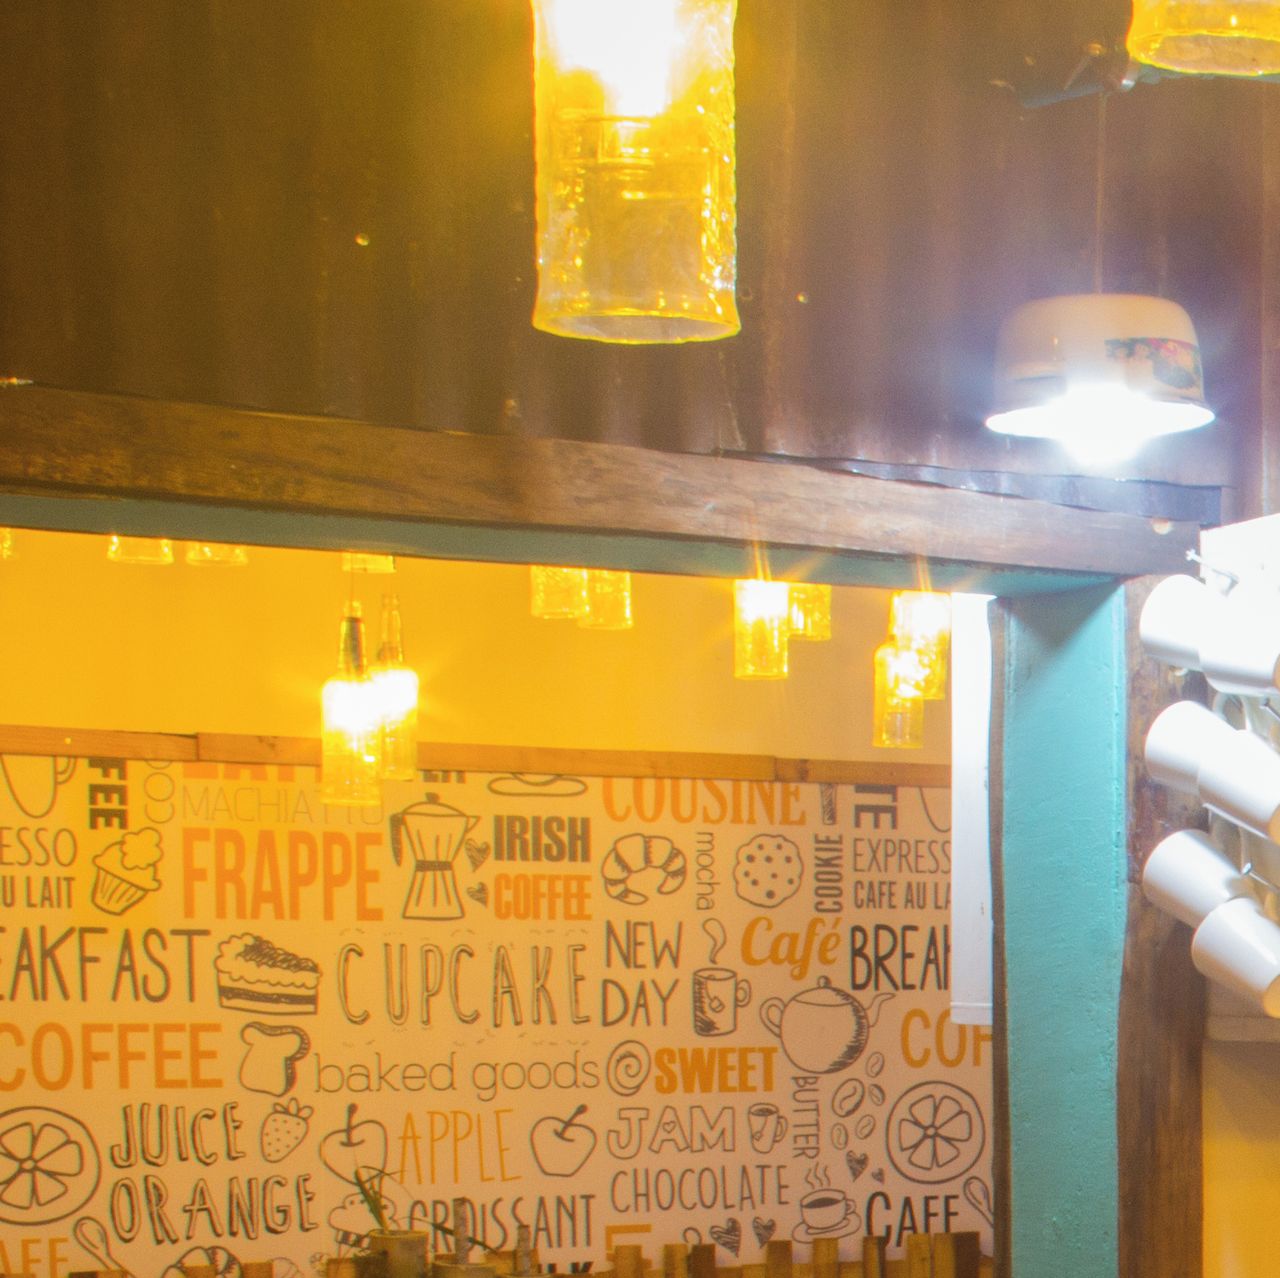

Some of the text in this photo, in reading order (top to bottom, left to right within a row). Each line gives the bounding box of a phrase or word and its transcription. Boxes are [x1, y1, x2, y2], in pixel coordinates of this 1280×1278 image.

[493, 815, 591, 863] IRISH
[696, 831, 721, 911] mocha
[25, 875, 76, 909] LAIT
[182, 826, 385, 921] FRAPPE
[493, 873, 593, 922] COFFEE
[814, 833, 843, 913] COOKIE
[853, 880, 897, 909] CAFE
[904, 882, 926, 909] AU
[0, 925, 212, 1003] AKFAST
[605, 920, 684, 970] NEW
[740, 916, 843, 981] Café
[337, 942, 592, 1029] CUPCAKE
[602, 978, 680, 1027] DAY
[0, 1022, 223, 1091] COFFEE
[314, 1050, 600, 1101] baked goods
[653, 1045, 778, 1095] SWEET
[110, 1101, 247, 1168] JUICE
[398, 1108, 522, 1186] APPLE
[607, 1105, 736, 1160] JAM
[792, 1076, 820, 1160] BUTTER
[110, 1173, 318, 1246] ORANGE
[610, 1164, 791, 1214] CHOCOLATE
